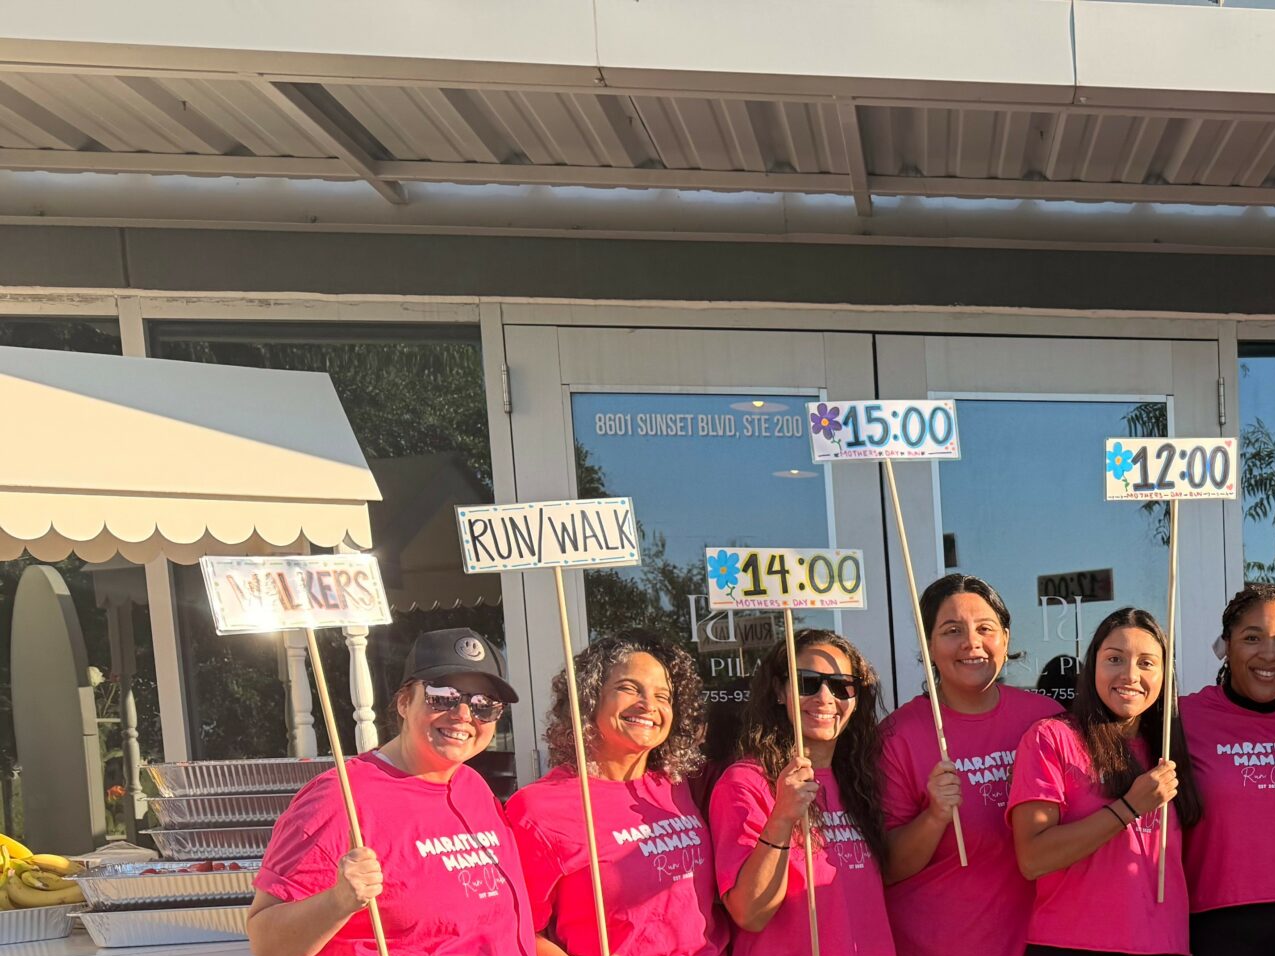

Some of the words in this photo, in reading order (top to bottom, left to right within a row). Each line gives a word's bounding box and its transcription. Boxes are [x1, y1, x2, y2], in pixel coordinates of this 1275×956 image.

[595, 413, 631, 436] 8601
[637, 413, 694, 436] SUNSET
[699, 414, 739, 439] BLVD,
[743, 415, 770, 437] STE
[774, 415, 802, 437] 200
[842, 404, 953, 448] 15:00
[885, 449, 900, 457] DAY
[1131, 443, 1230, 491] 12:00
[468, 508, 635, 563] RUN/WALK
[741, 553, 861, 596] 14:00
[736, 599, 781, 607] MOTHERS
[793, 599, 809, 607] DAY
[820, 599, 838, 607] RUN
[612, 815, 702, 845] MARATHON
[639, 831, 701, 857] MAMAS
